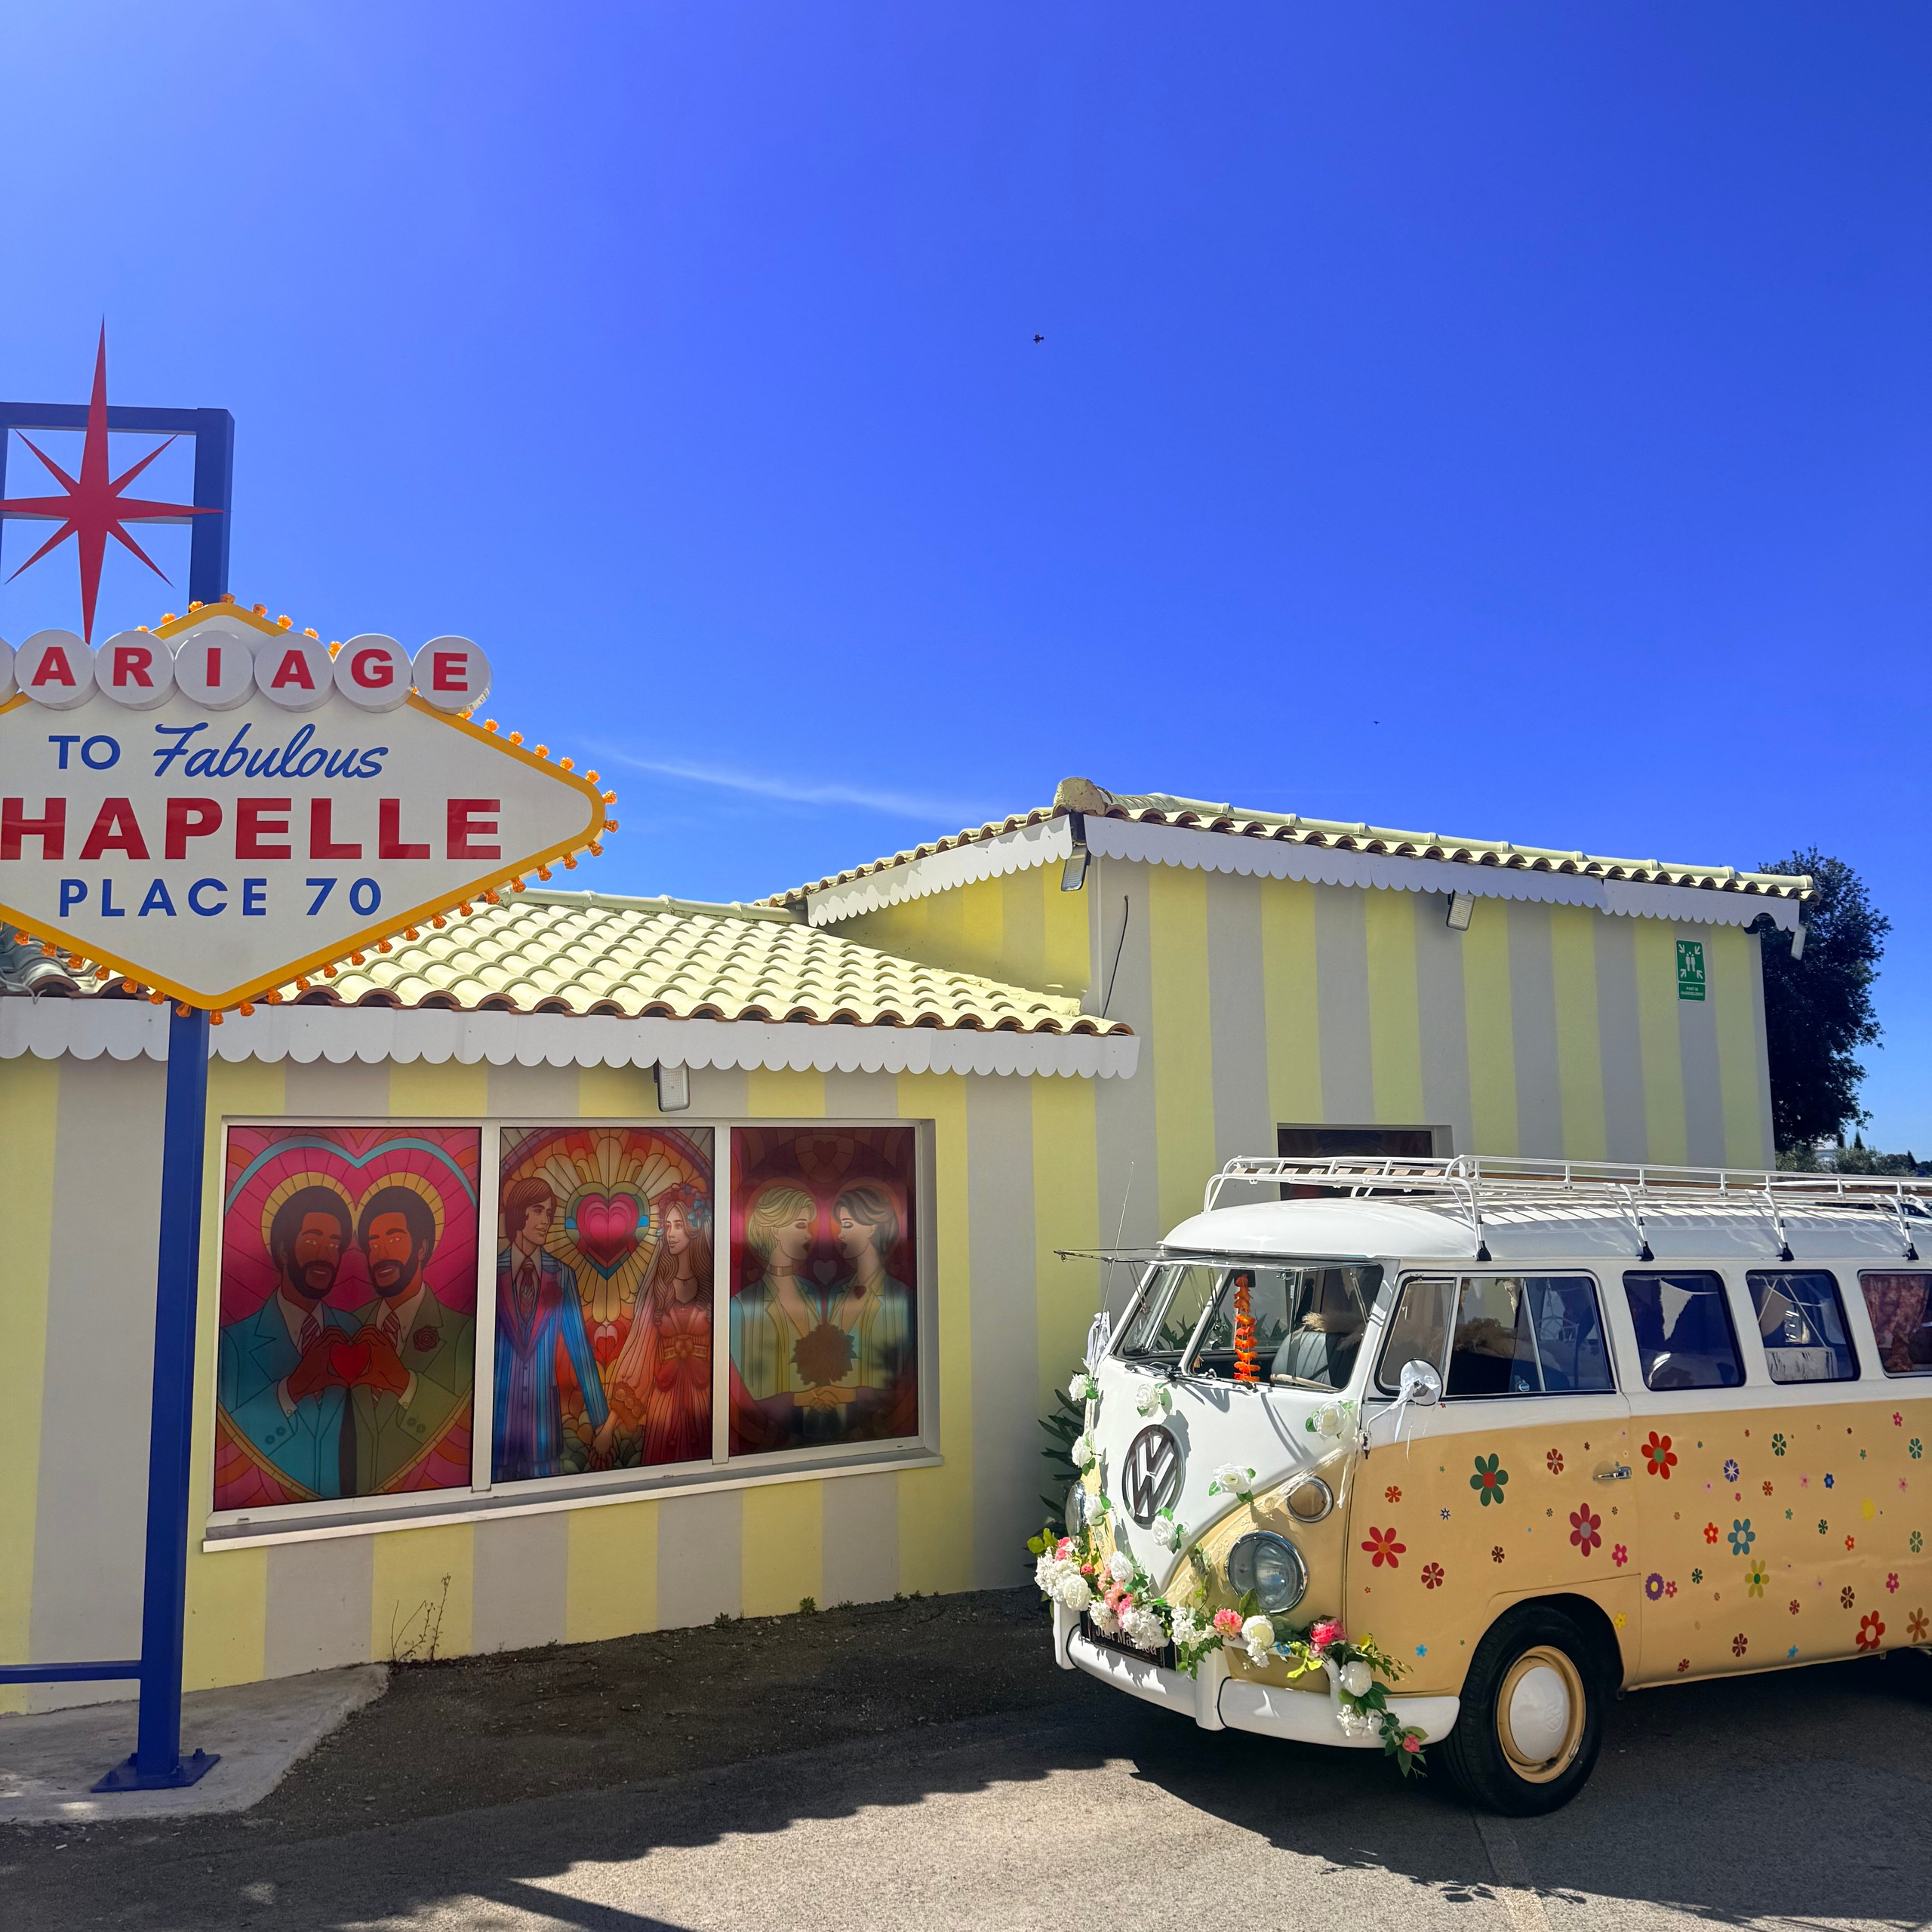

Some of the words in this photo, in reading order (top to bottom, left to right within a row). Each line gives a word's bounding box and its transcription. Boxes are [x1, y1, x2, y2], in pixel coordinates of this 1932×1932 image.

[31, 646, 468, 691] ARIAGE
[48, 735, 121, 770] TO
[153, 721, 389, 779] Fabulous
[0, 797, 501, 860] HAPELLE
[60, 878, 267, 917] PLACE
[306, 878, 381, 916] 70
